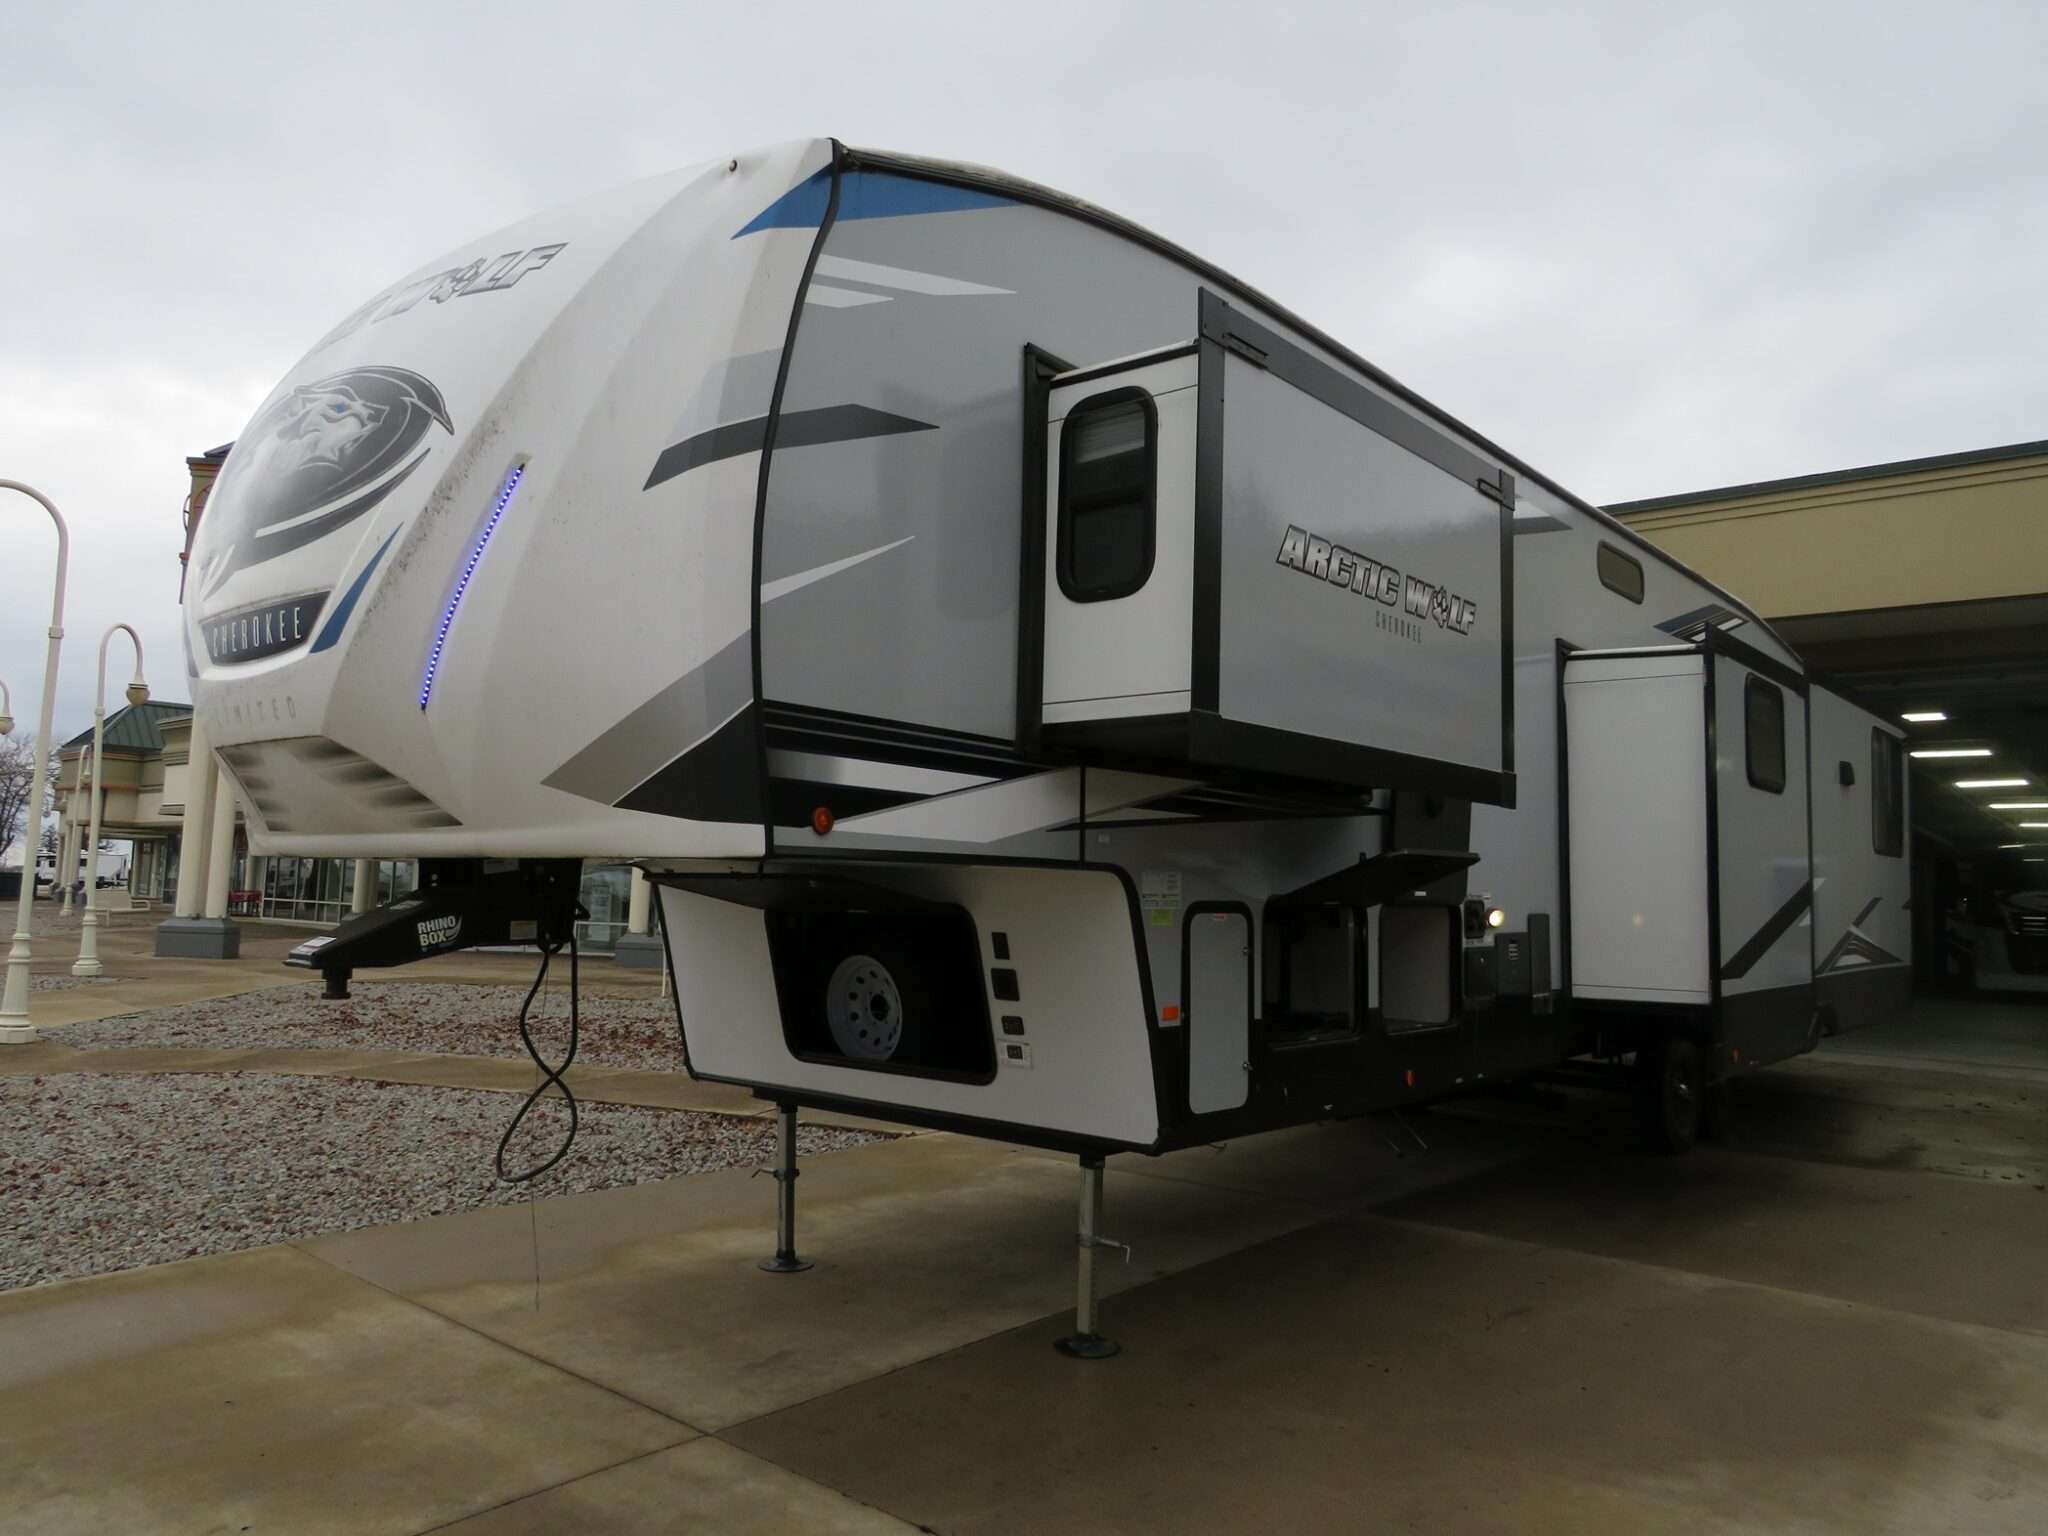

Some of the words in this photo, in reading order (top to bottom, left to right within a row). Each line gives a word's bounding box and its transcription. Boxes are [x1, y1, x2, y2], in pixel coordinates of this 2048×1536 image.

[1276, 524, 1400, 607] ARCTIC
[213, 607, 302, 657] CHEROKEE
[1375, 610, 1422, 644] CHEROKEE
[417, 915, 456, 934] RHINO
[419, 930, 447, 946] BOX
